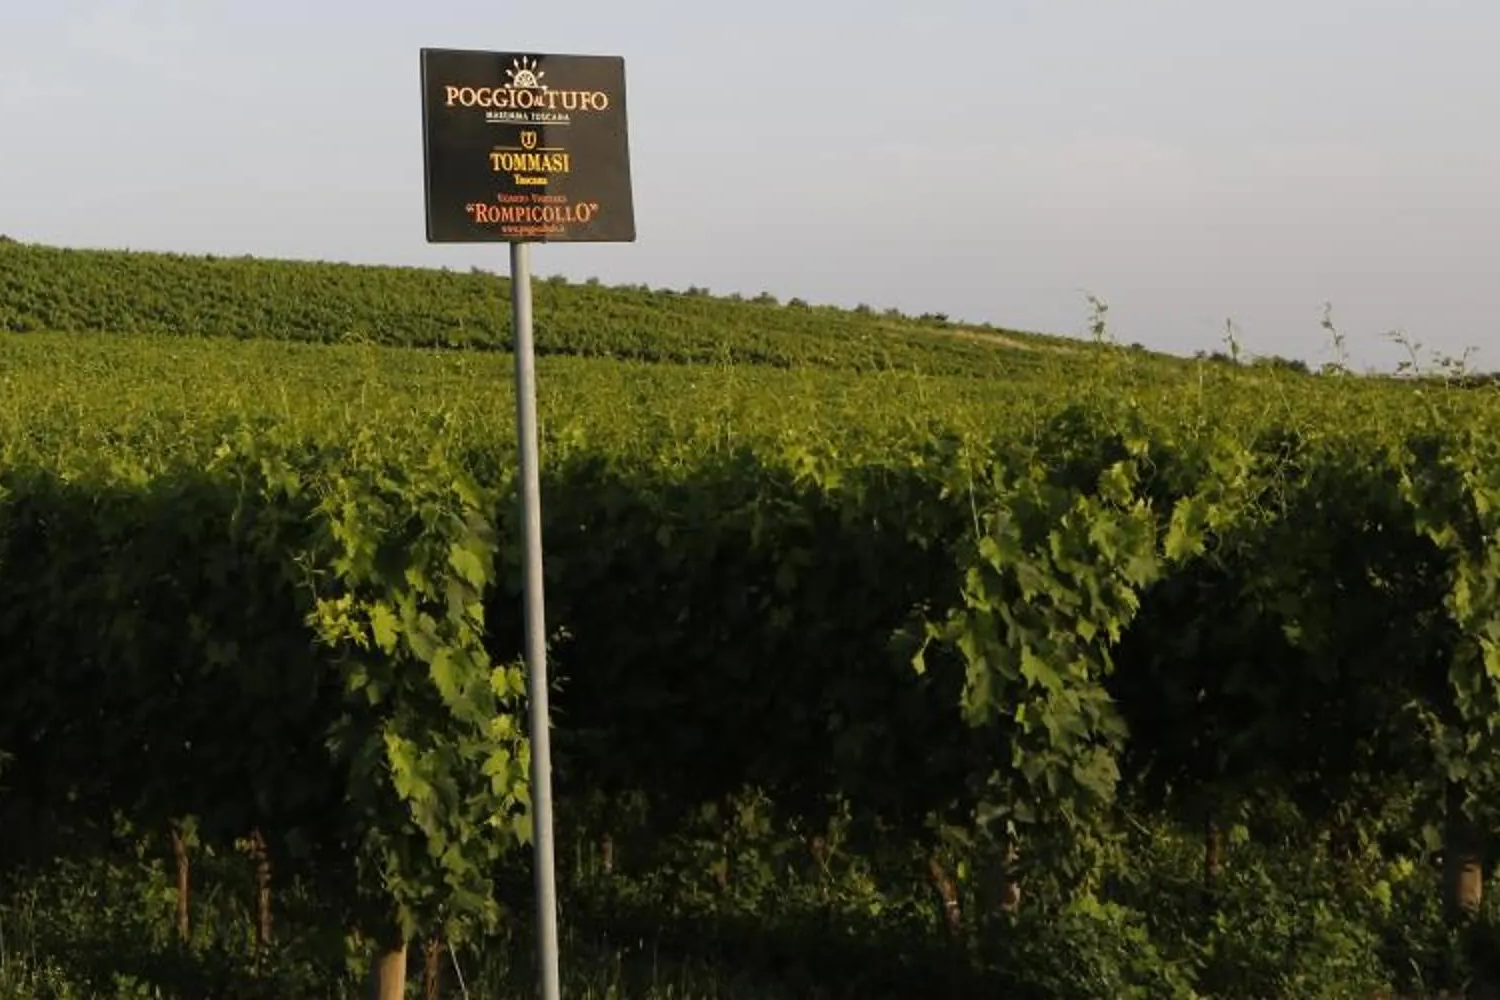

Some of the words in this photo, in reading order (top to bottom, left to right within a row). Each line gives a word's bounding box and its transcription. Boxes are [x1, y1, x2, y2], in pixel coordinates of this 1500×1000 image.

[446, 86, 532, 108] POGGIO
[545, 90, 609, 111] TUFO
[489, 153, 570, 172] TOMMASI
